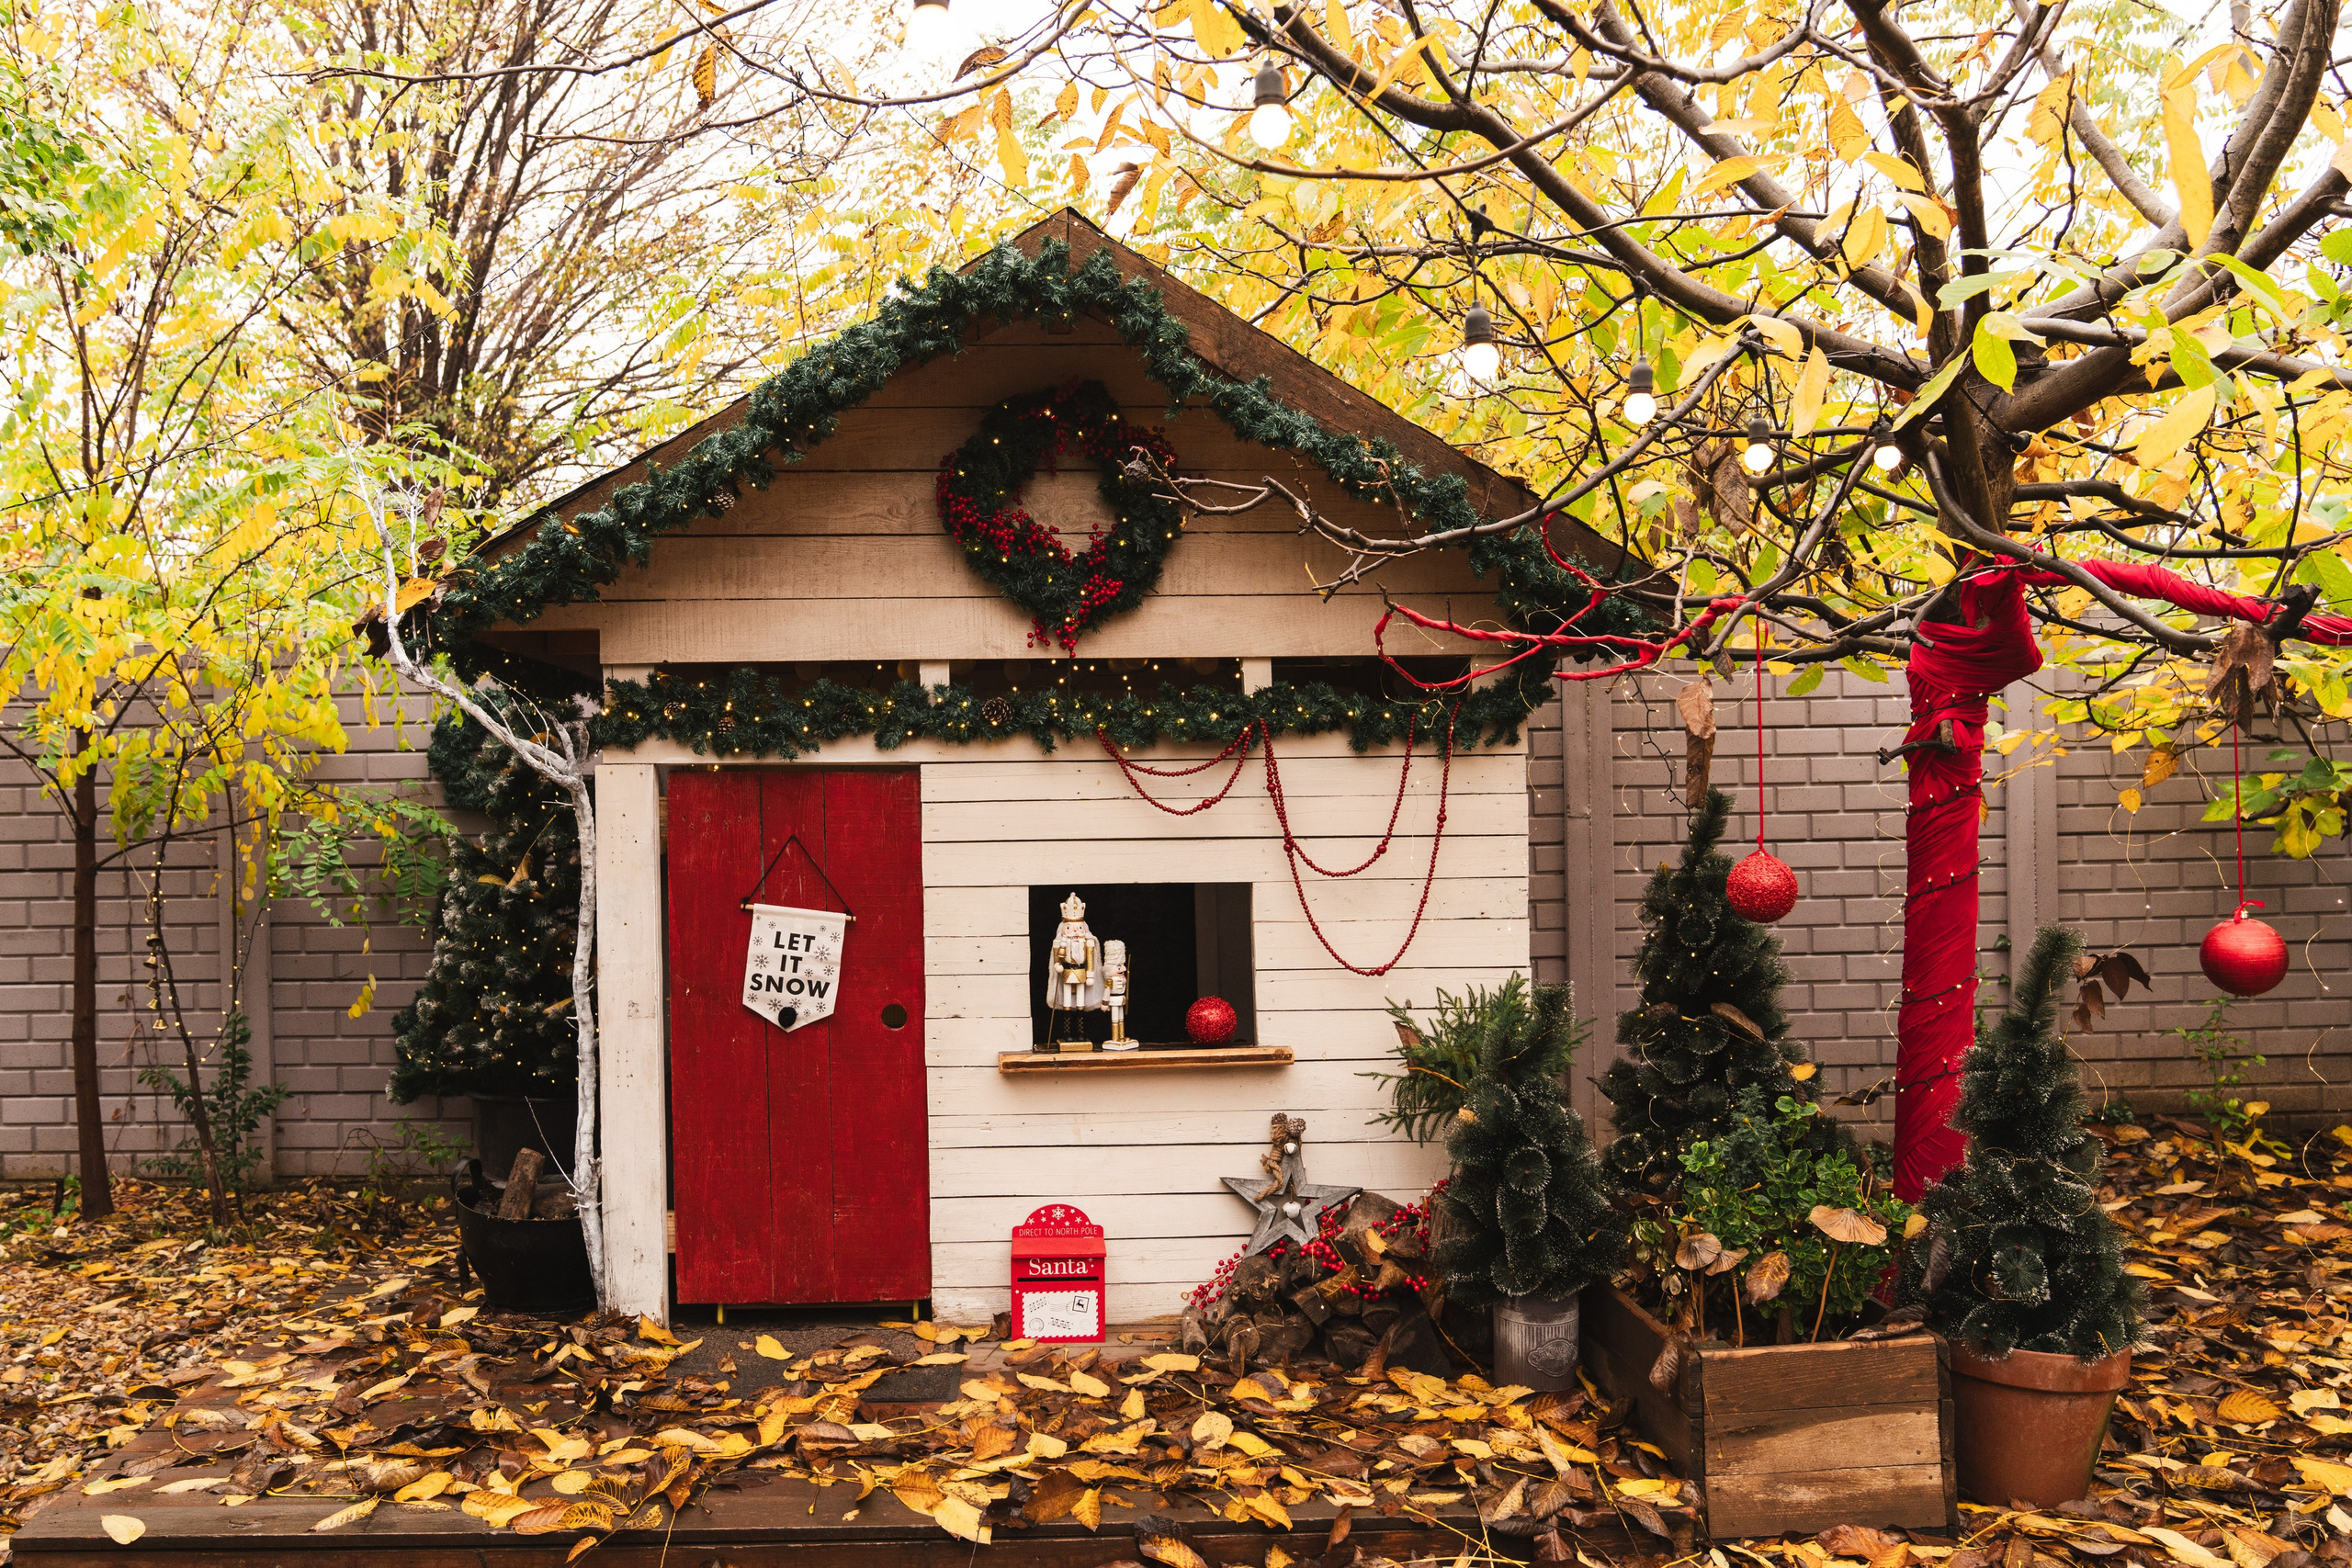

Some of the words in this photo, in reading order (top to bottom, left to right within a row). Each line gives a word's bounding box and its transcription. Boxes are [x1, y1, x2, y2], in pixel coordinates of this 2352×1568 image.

[774, 931, 816, 953] LET
[780, 954, 803, 974] IT
[750, 973, 831, 998] SNOW
[1019, 1228, 1042, 1236] DIRECT
[1045, 1227, 1054, 1236] TO
[1056, 1227, 1079, 1235] NORTH
[1080, 1226, 1097, 1235] POLE
[1029, 1258, 1089, 1276] Santa
